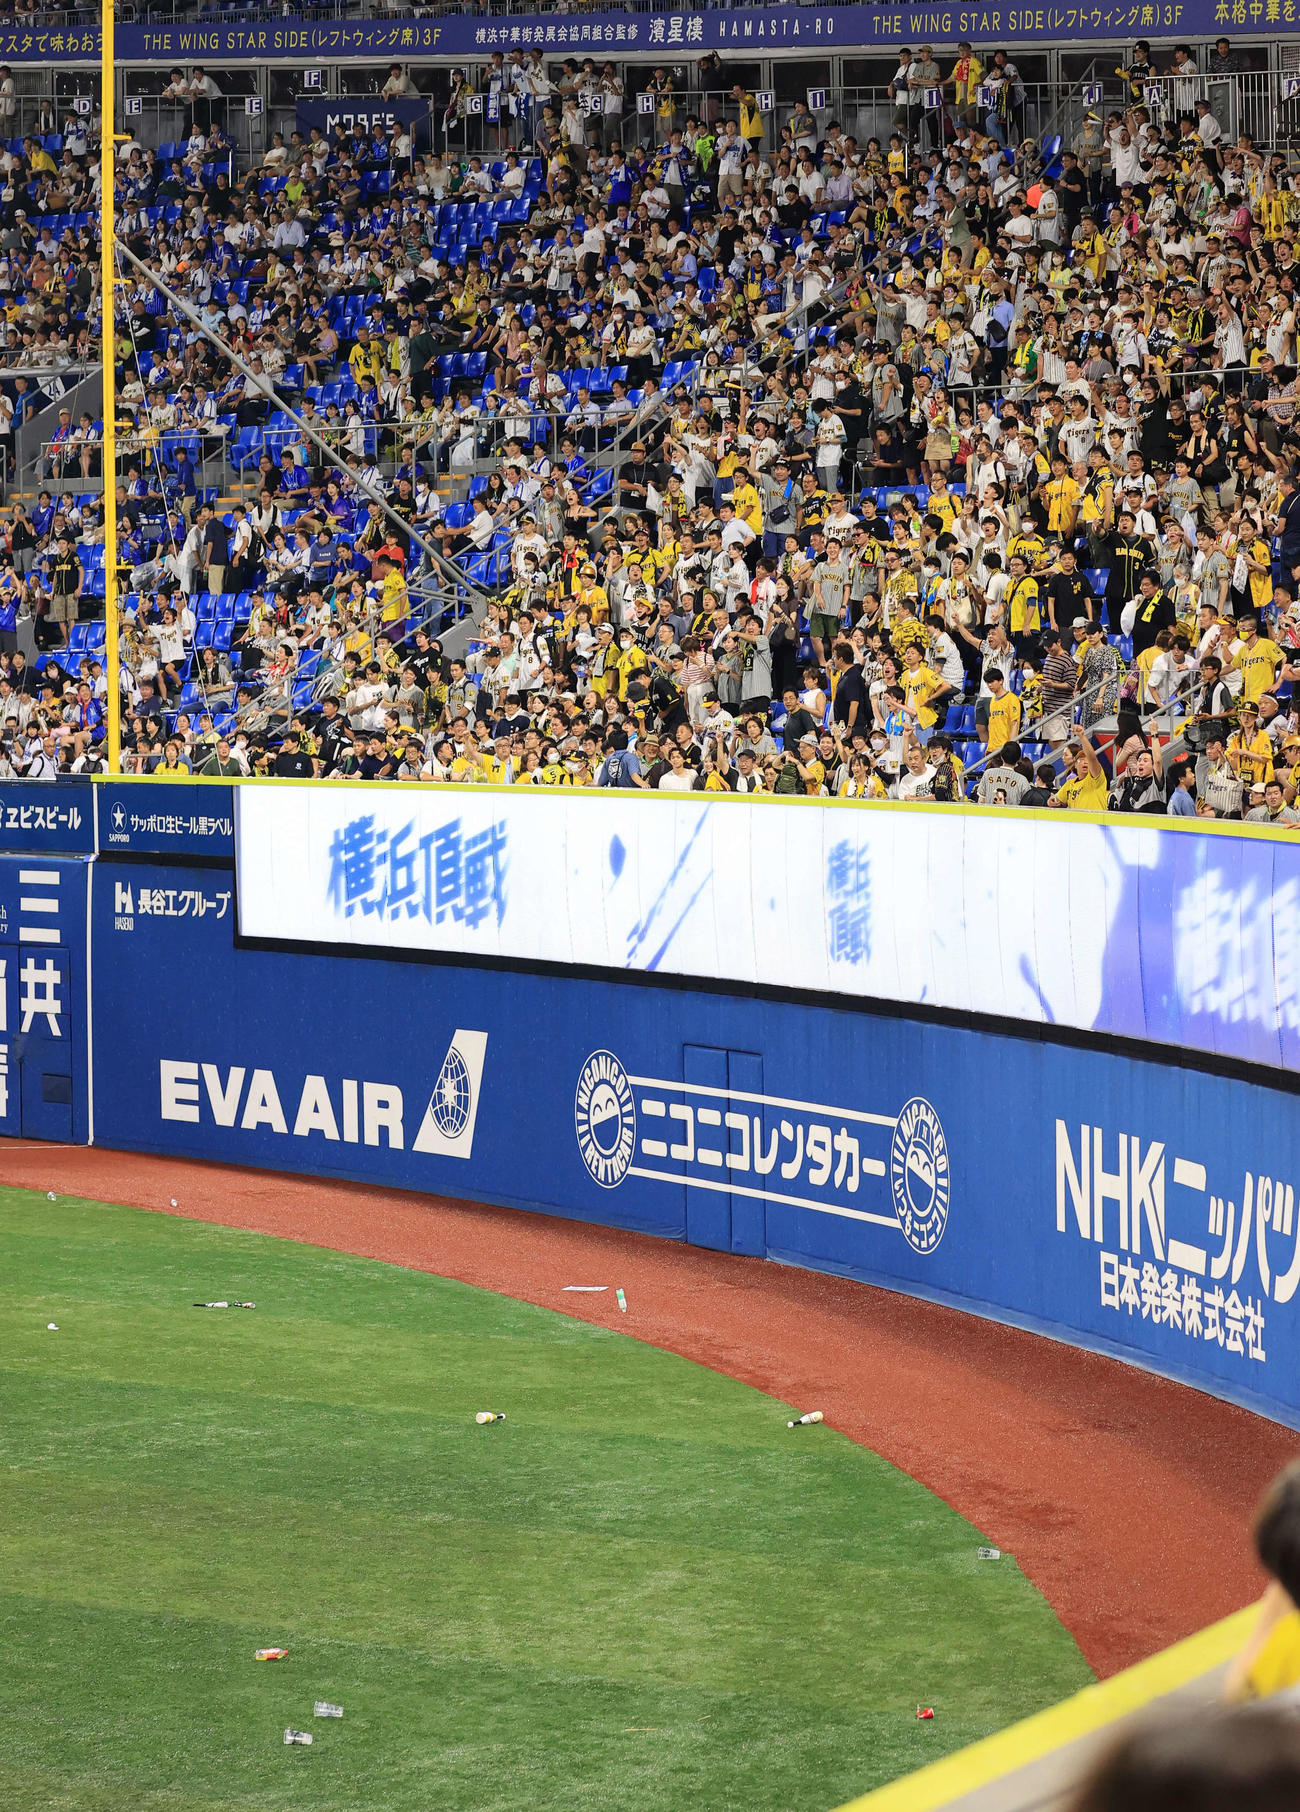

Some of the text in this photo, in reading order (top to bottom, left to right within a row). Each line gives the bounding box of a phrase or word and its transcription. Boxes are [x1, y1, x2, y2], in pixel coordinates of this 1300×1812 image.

[1214, 0, 1300, 25] 本格中華を
[720, 17, 835, 37] HAMASTA-RO
[872, 15, 902, 35] THE
[910, 13, 952, 33] WING
[959, 11, 1000, 31] STAR
[144, 33, 172, 50] THE
[179, 32, 219, 50] WING
[227, 31, 266, 49] STAR
[1067, 428, 1090, 438] Tigers
[833, 584, 839, 592] 8
[528, 656, 533, 664] 8
[988, 775, 1017, 788] SATO
[130, 814, 233, 836] サッポロ生ビール黒ラベル
[108, 833, 130, 843] SAPPORO
[114, 916, 134, 931] HASEKO
[641, 1099, 886, 1193] ニコニコレンタカー
[1099, 1249, 1266, 1363] 日本発条株式会社
